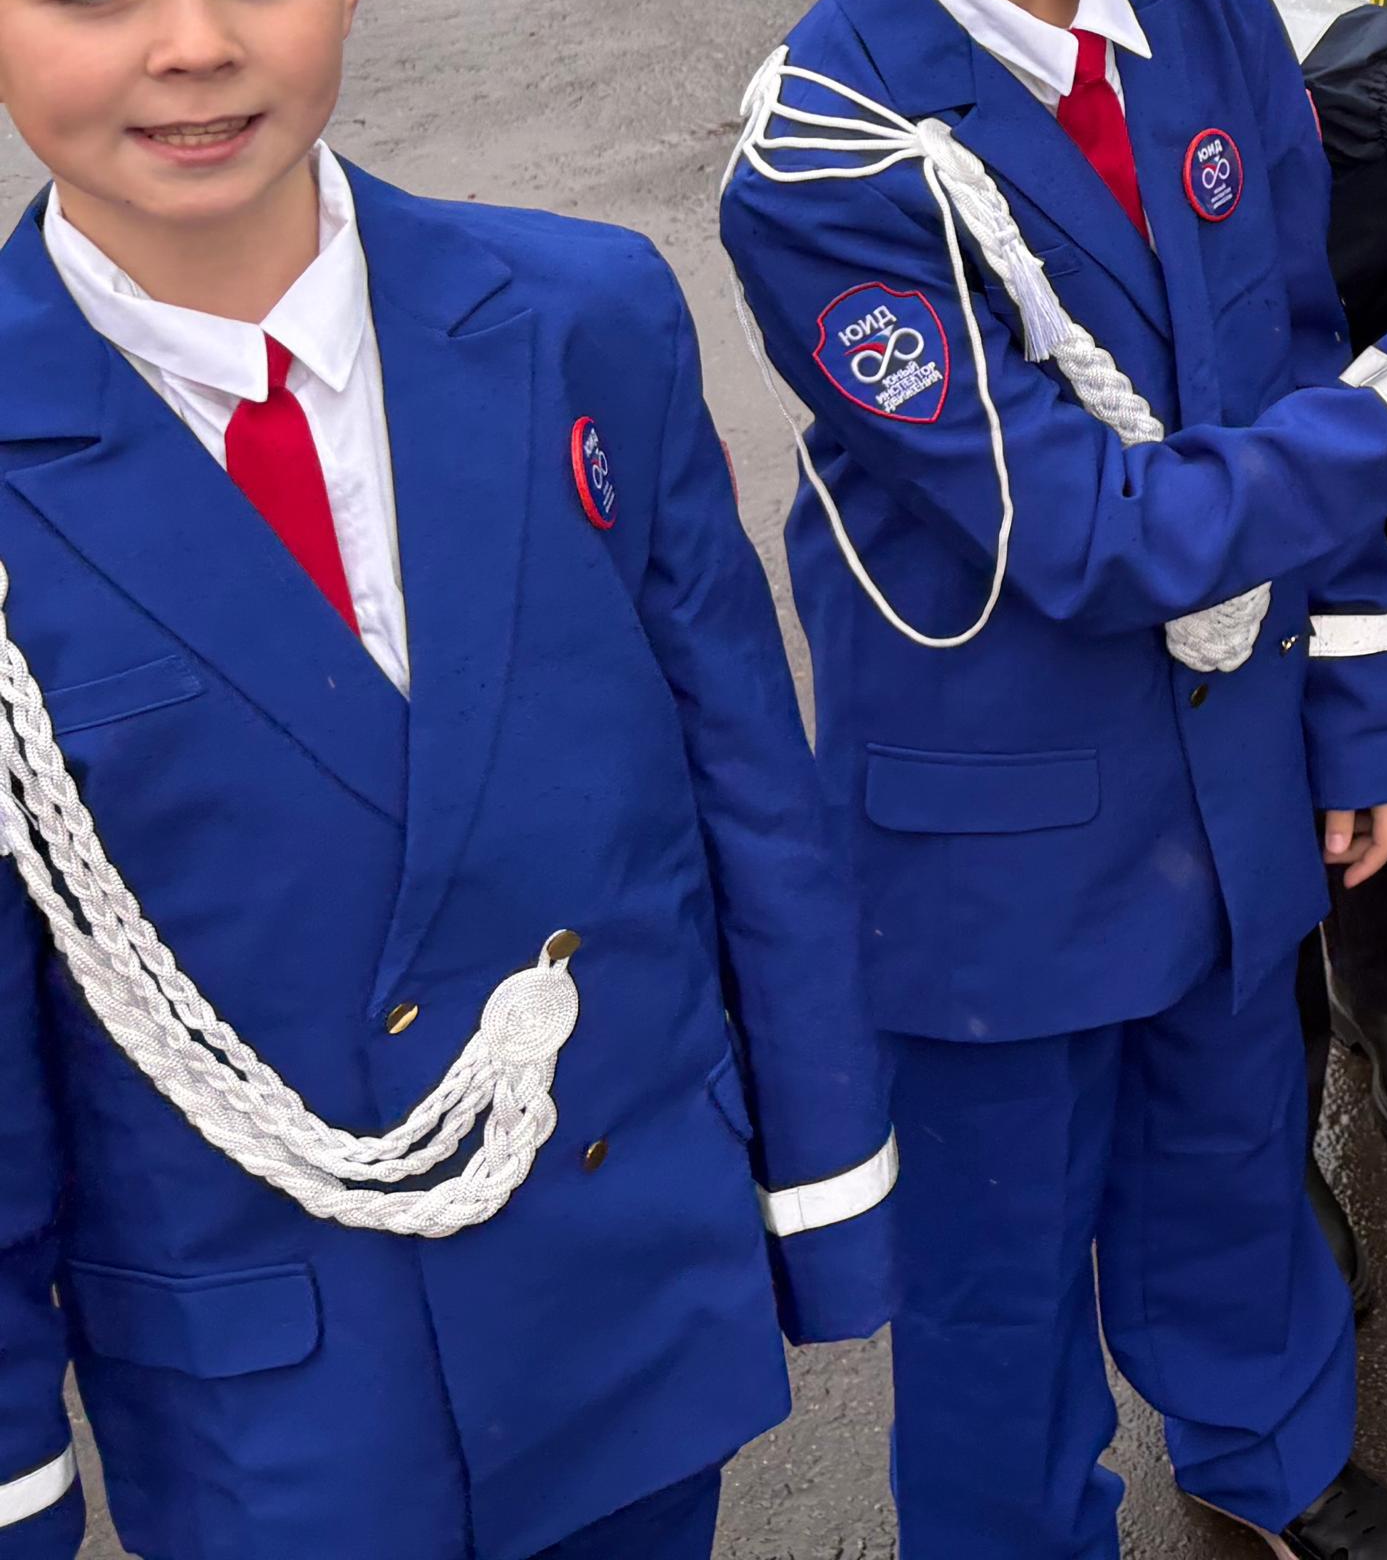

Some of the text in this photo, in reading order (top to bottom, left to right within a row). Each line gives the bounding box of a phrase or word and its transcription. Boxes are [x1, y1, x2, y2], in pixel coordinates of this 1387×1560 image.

[1197, 138, 1223, 162] ЮИД
[838, 305, 897, 347] ЮИД
[875, 360, 937, 405] ИНСПЕКТОР
[882, 360, 920, 388] ЮНЫЙ
[883, 369, 943, 413] ДВИЖЕНИЯ
